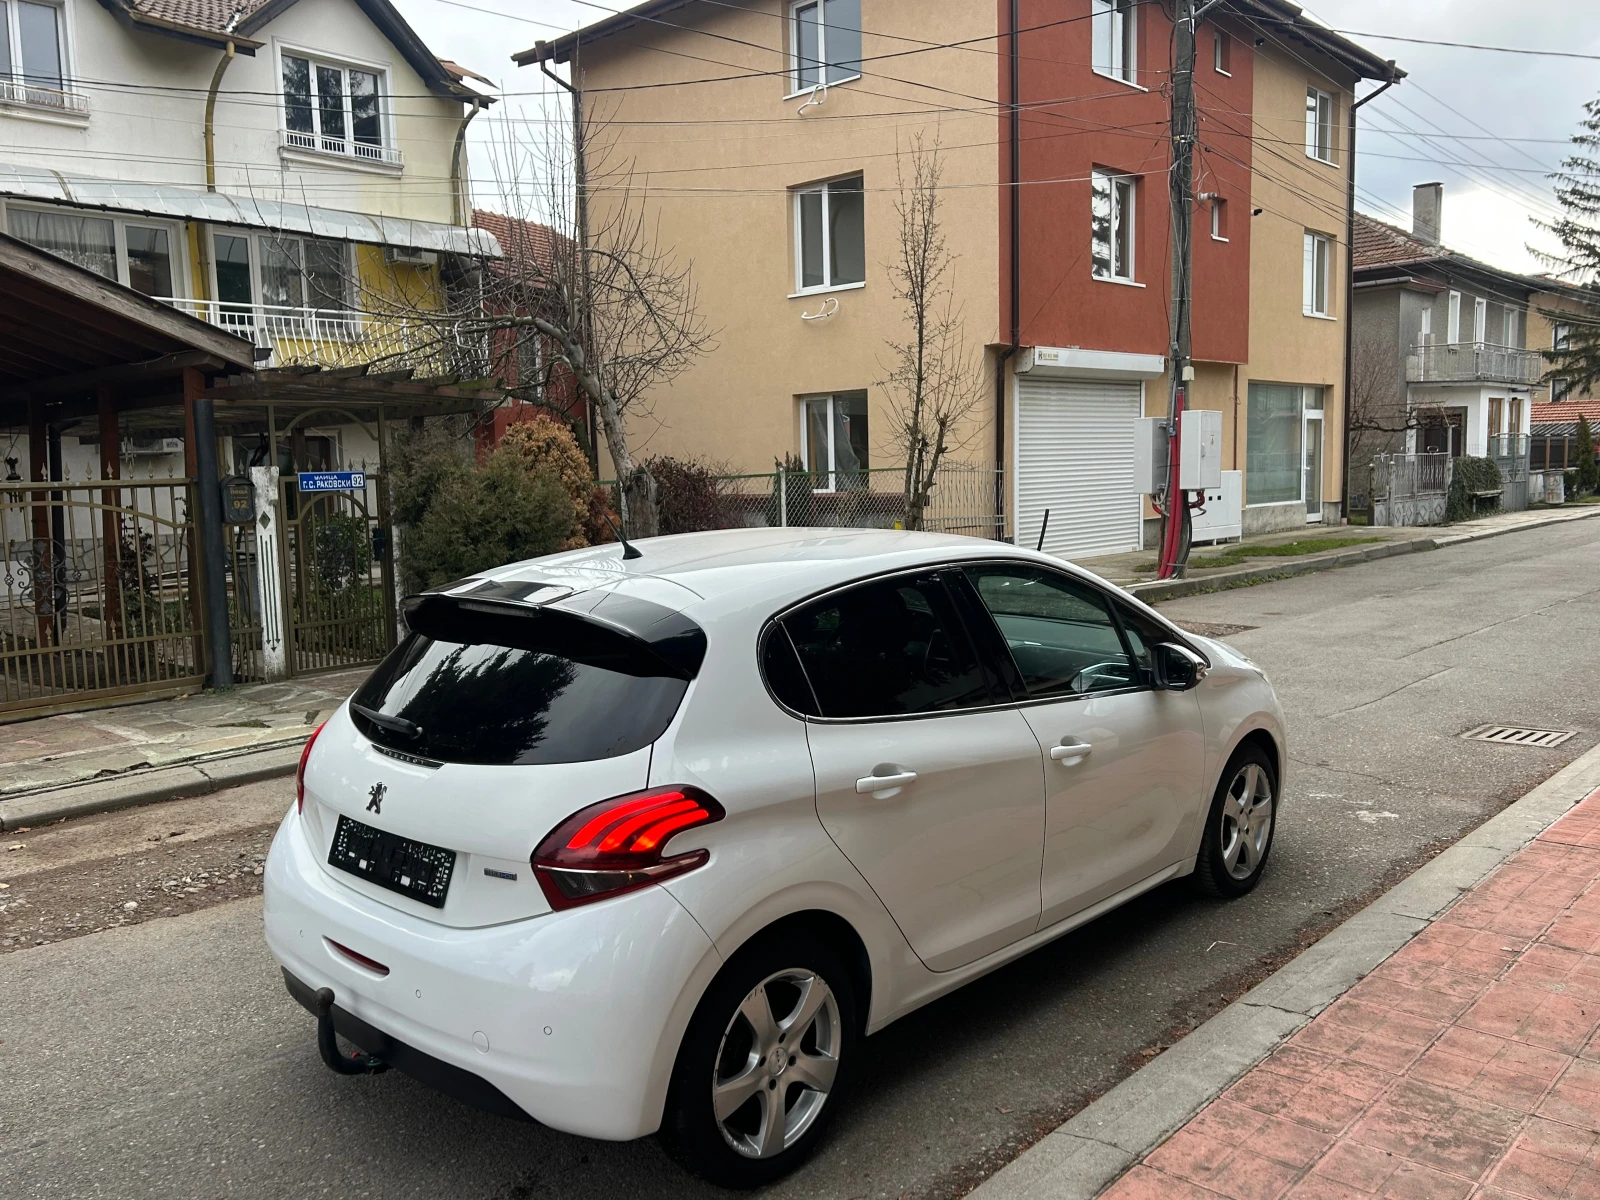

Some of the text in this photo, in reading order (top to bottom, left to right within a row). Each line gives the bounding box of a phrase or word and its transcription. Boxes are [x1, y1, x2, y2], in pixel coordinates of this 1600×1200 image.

[316, 480, 351, 488] РАКОВСКИ
[353, 476, 362, 485] 92
[233, 500, 248, 509] 92
